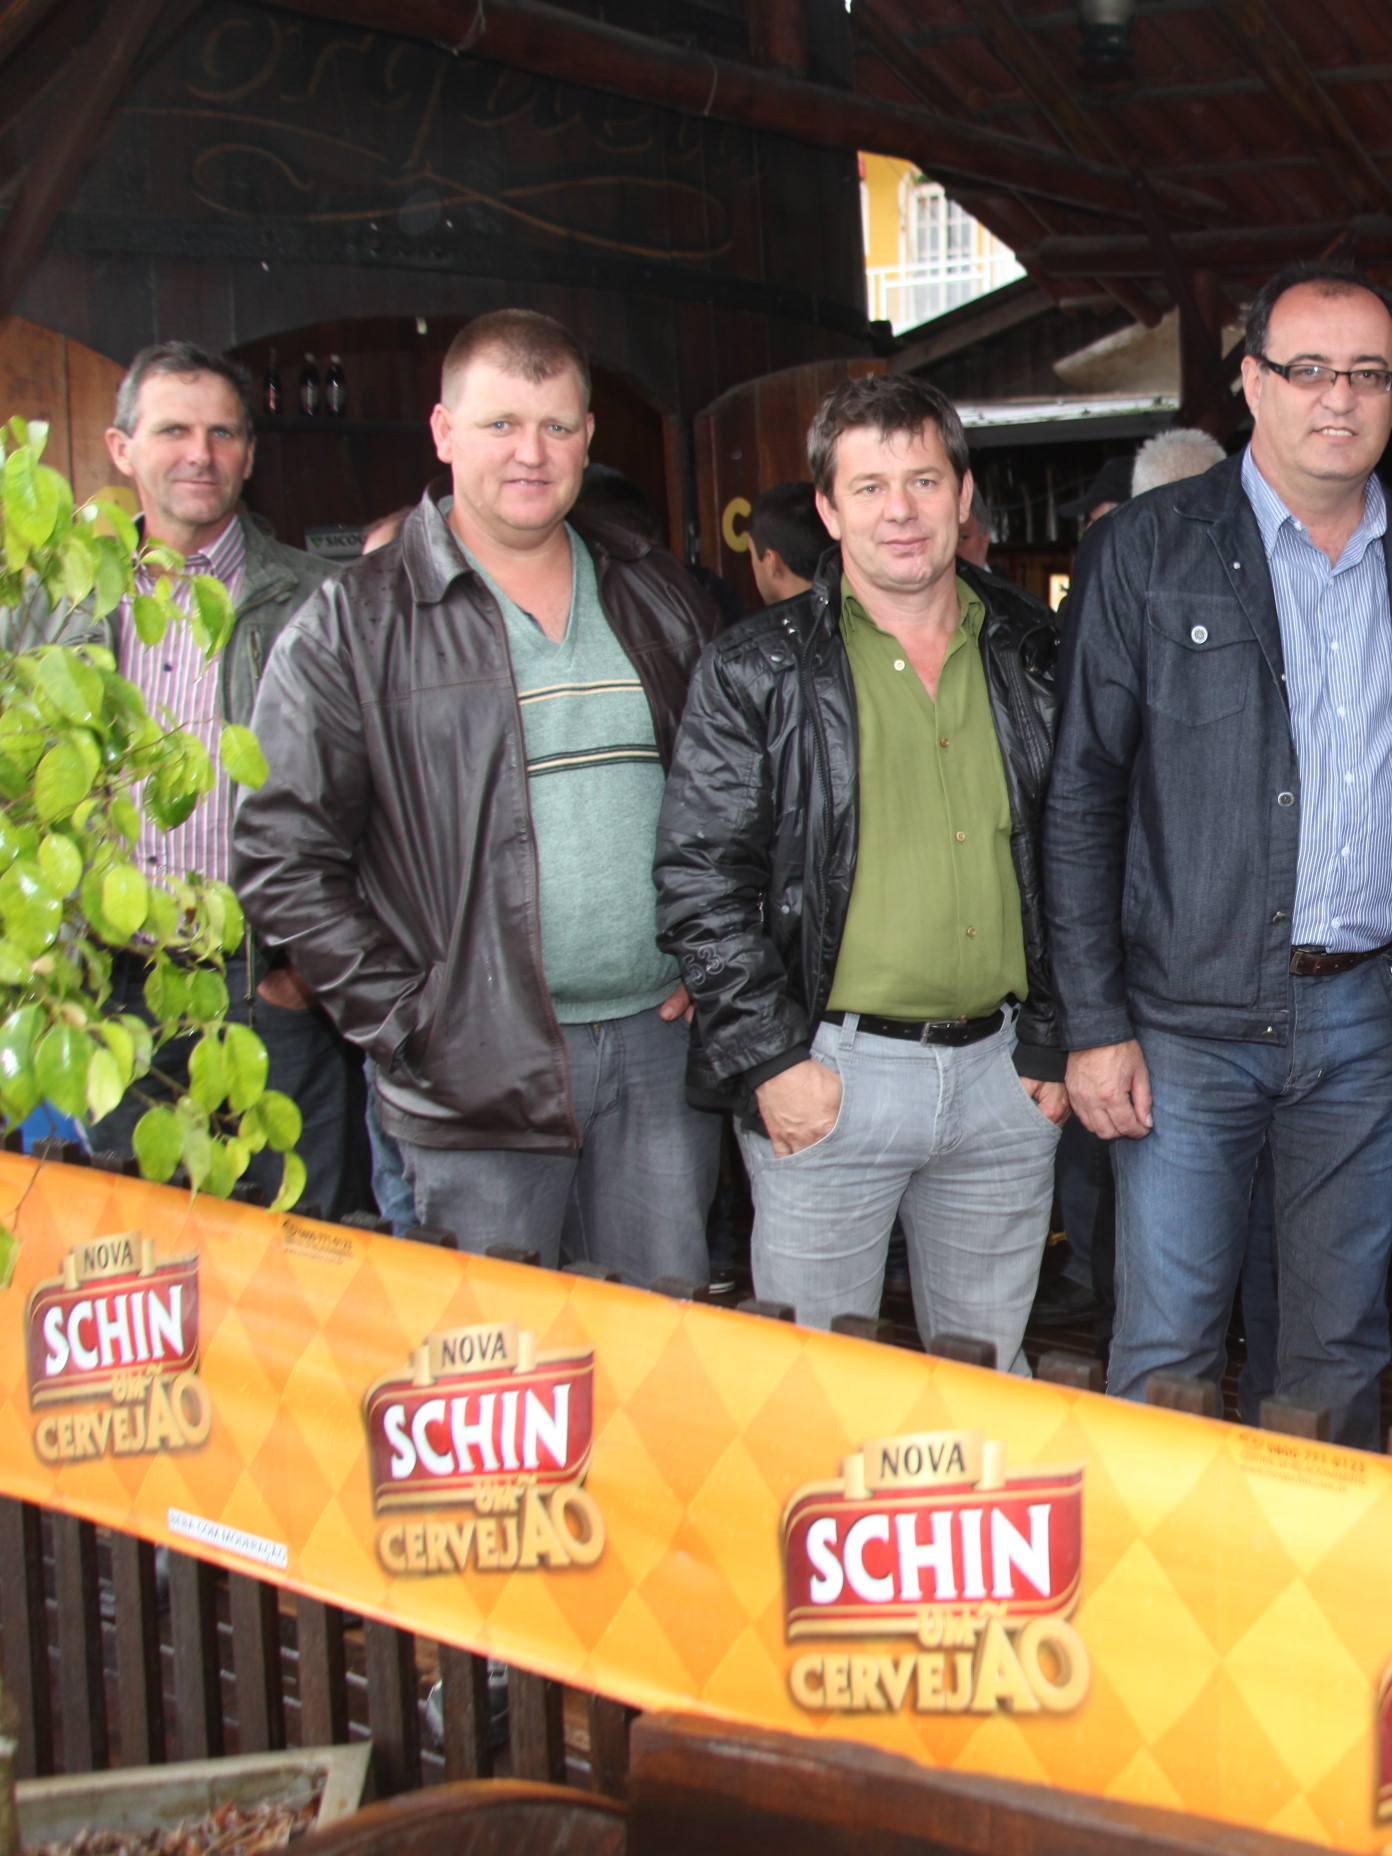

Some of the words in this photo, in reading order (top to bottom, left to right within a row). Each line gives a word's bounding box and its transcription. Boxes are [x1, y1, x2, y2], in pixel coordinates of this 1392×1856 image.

[83, 1239, 134, 1274] NOVA
[42, 1283, 185, 1377] SCHIN
[441, 1331, 507, 1369] NOVA
[36, 1362, 212, 1462] CERVEJÃO
[111, 1371, 146, 1402] UM
[382, 1382, 572, 1479] SCHIN
[880, 1441, 967, 1480] NOVA
[379, 1472, 606, 1573] CERVEJÃO
[474, 1479, 520, 1514] UM
[805, 1503, 1052, 1604] SCHIN
[789, 1601, 1091, 1714] CERVEJÃO
[917, 1609, 977, 1649] UM
